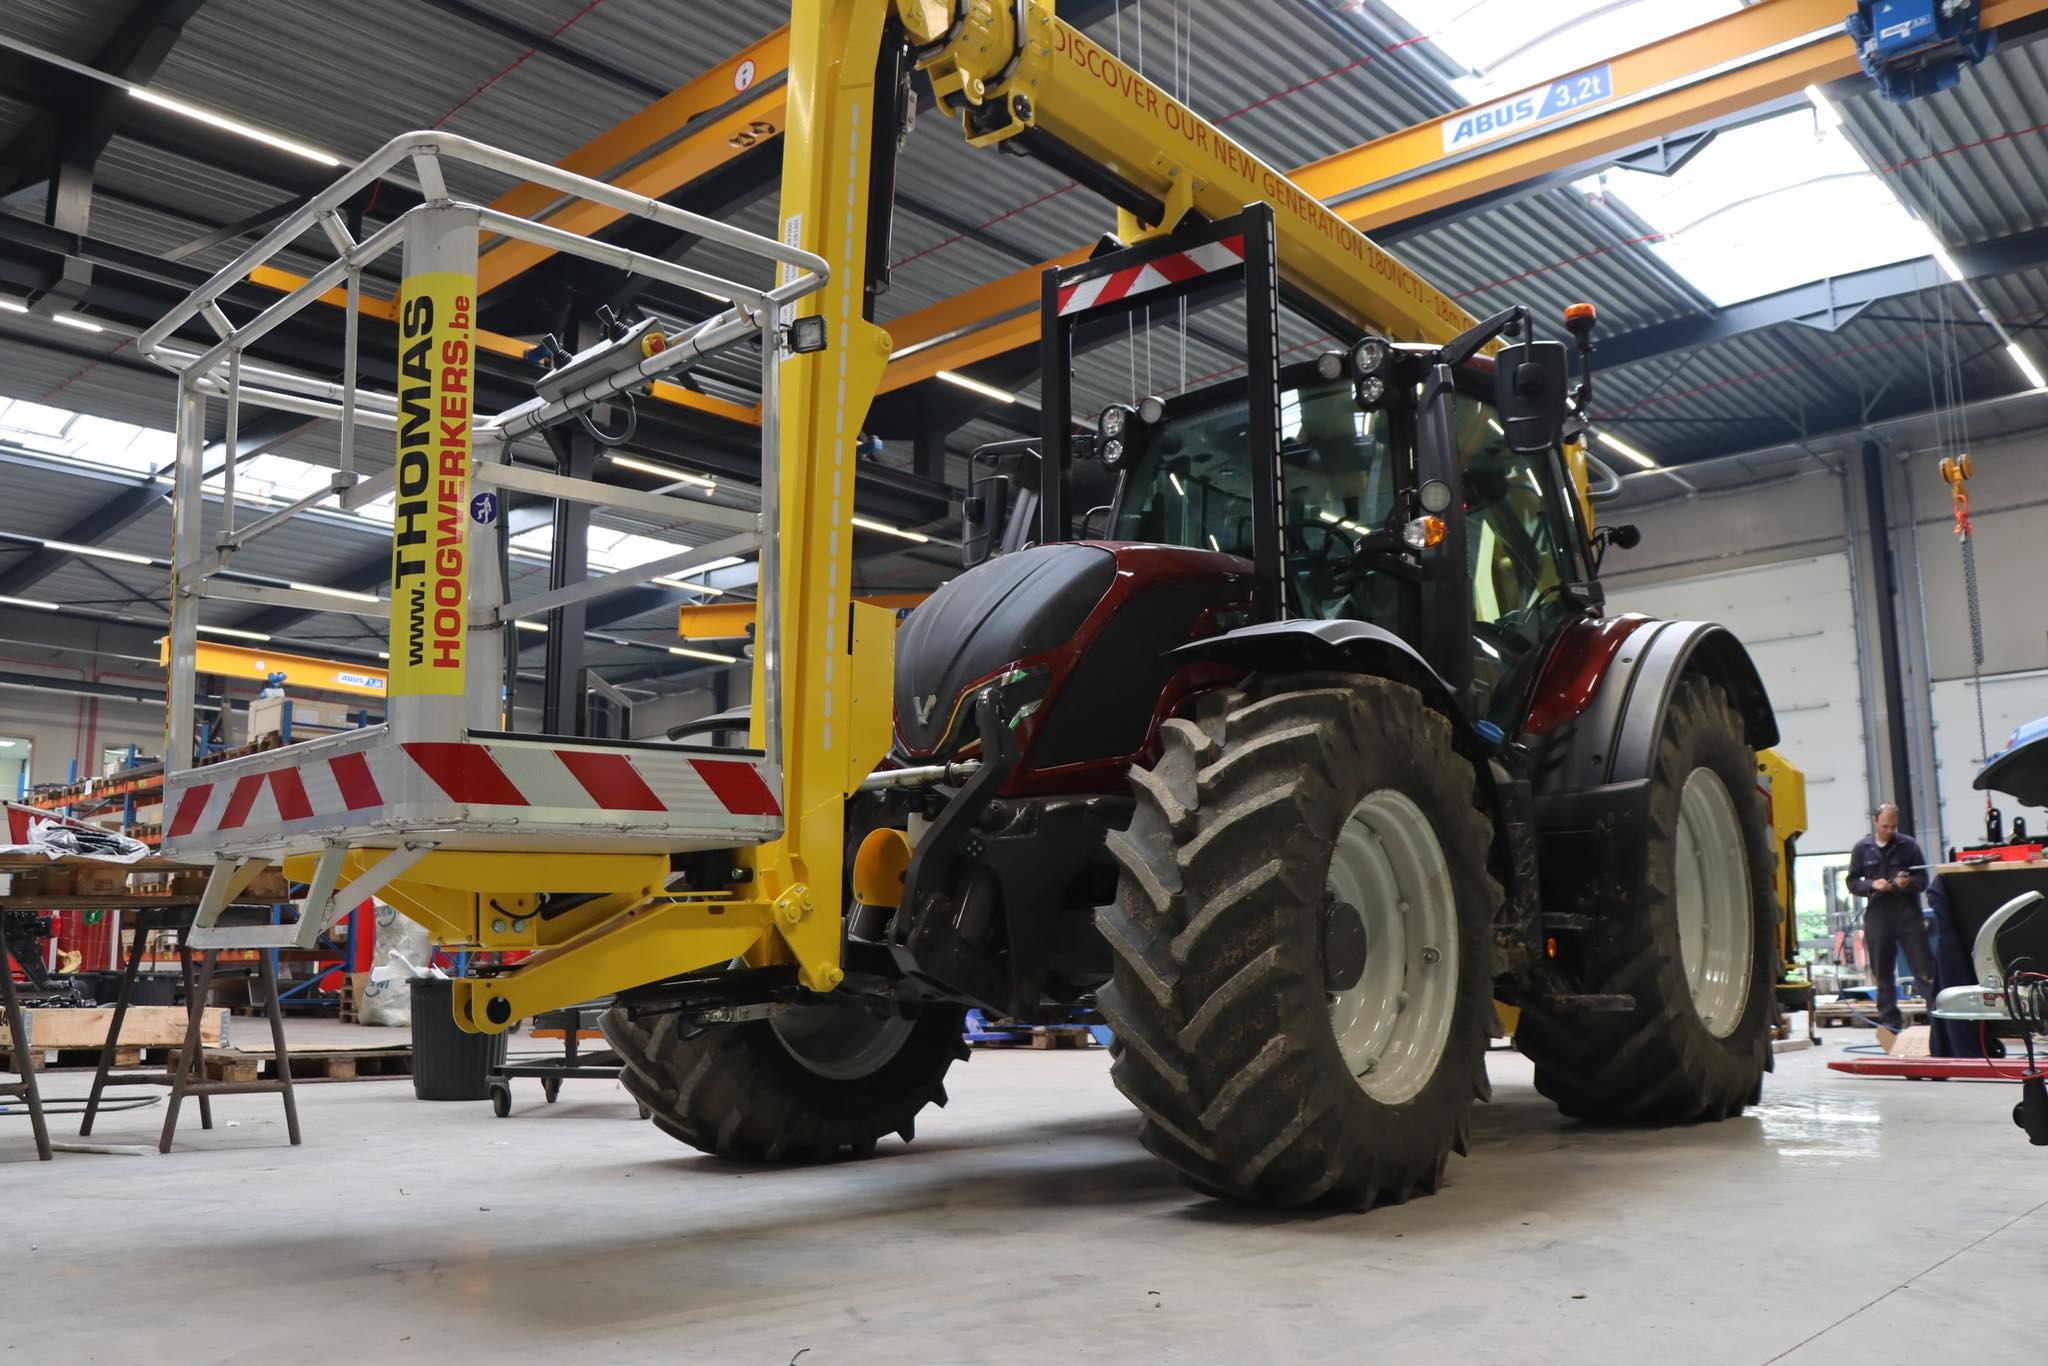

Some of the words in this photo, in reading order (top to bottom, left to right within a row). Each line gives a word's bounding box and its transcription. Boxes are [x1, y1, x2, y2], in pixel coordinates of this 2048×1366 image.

[1055, 24, 1159, 119] DISCOVER
[1165, 103, 1209, 152] OUR
[1214, 135, 1256, 184] NEW
[1263, 172, 1363, 260] GENERATION
[1452, 97, 1534, 143] ABUS
[1555, 75, 1602, 107] 3,2t
[395, 295, 434, 667] www.THOMAS
[432, 295, 471, 668] HOOGWERKERS.be
